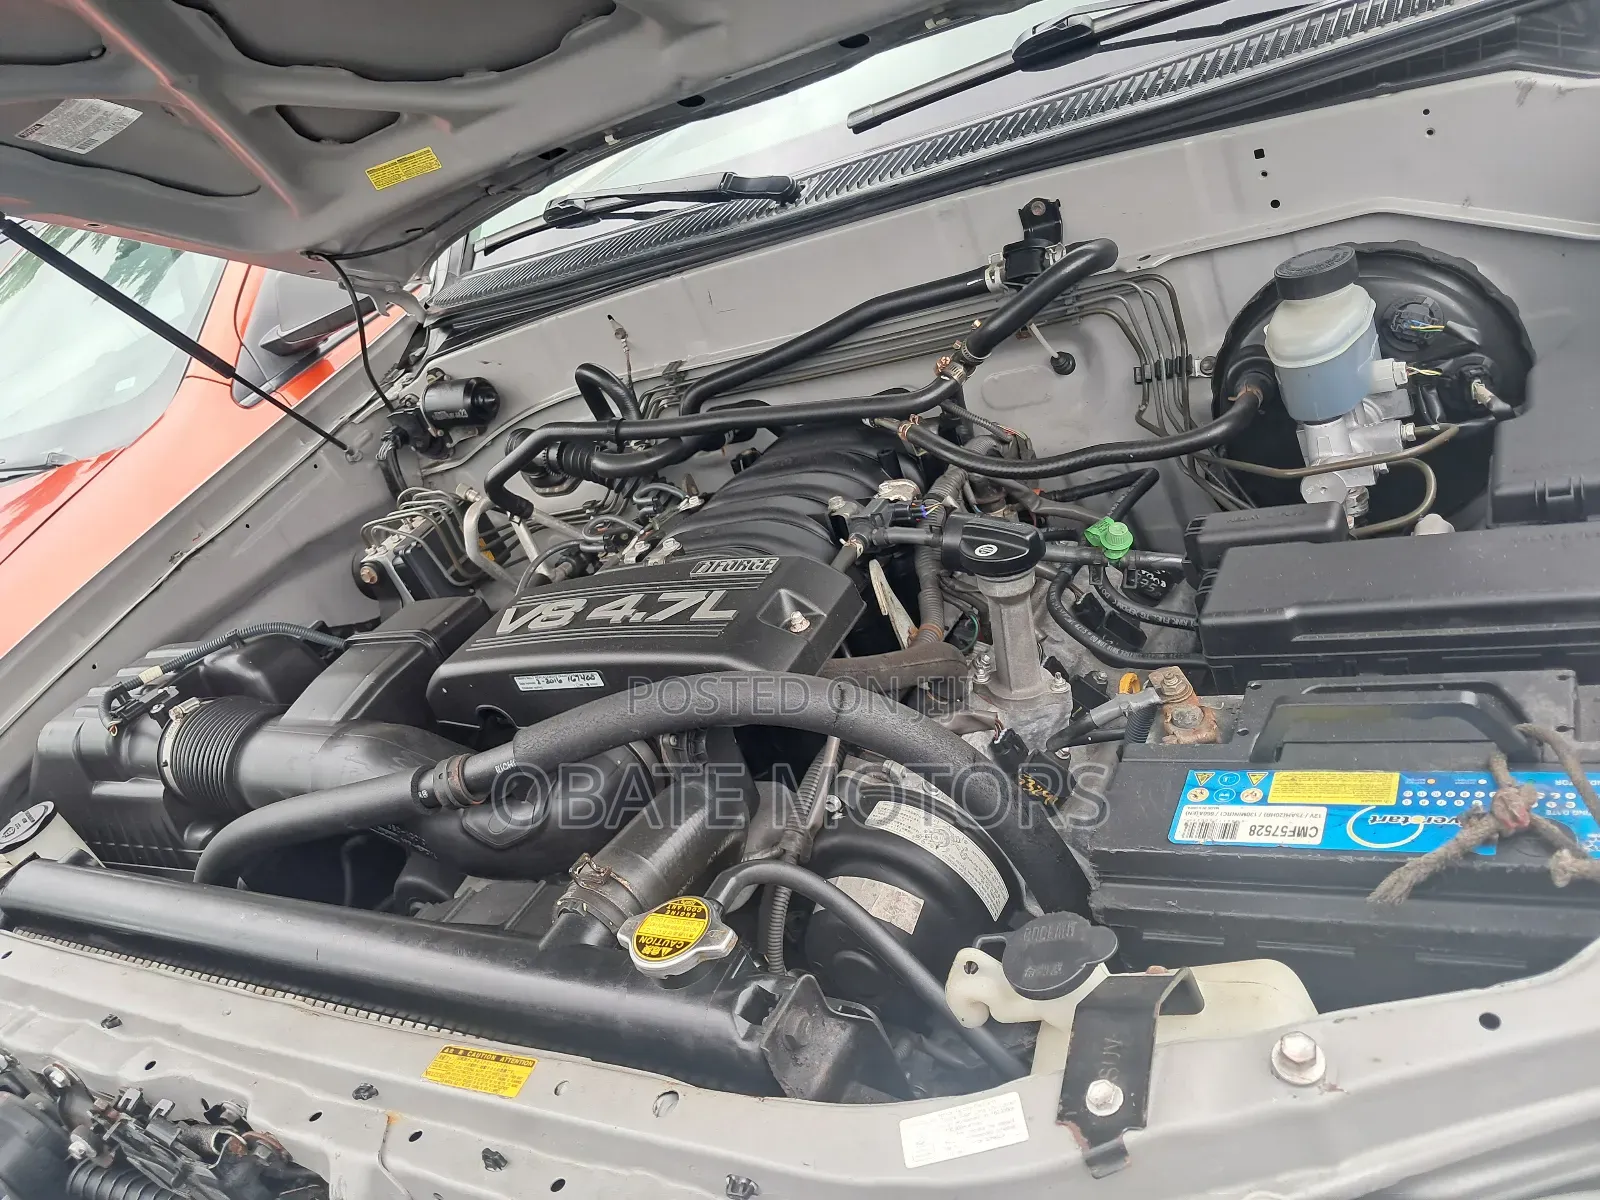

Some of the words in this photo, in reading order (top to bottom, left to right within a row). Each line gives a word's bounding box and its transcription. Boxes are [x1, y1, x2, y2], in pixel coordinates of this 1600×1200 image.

[496, 598, 587, 636] V8
[587, 590, 739, 624] 4.7L
[1248, 824, 1319, 839] CMF57528
[665, 910, 696, 918] ENGINE
[666, 904, 702, 913] COOLANT
[639, 936, 685, 949] CAUTION
[467, 1050, 497, 1061] CAUTION
[500, 1054, 534, 1067] ATTENTION
